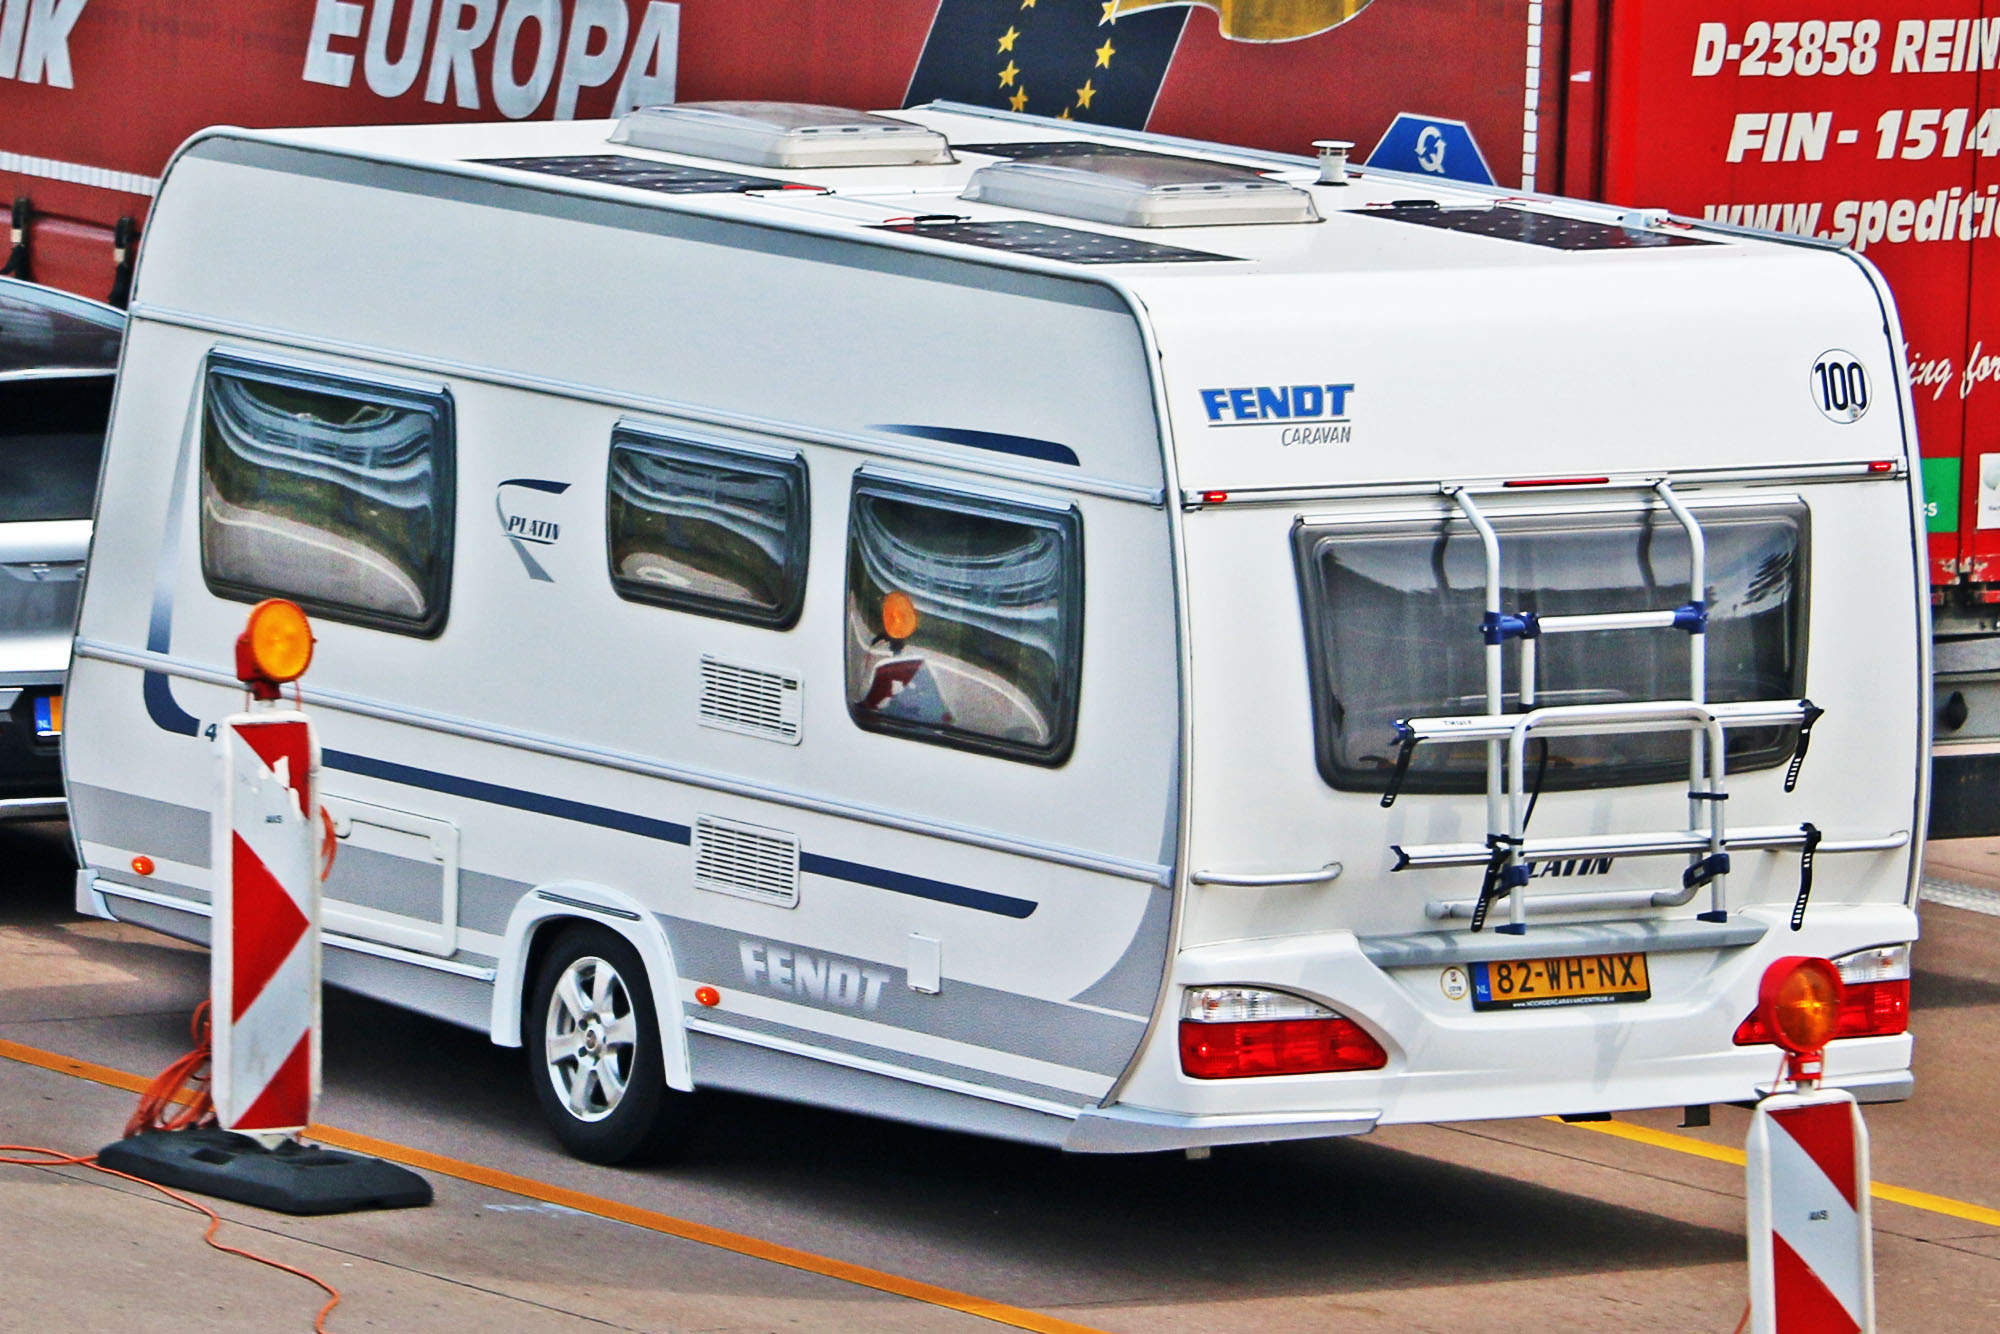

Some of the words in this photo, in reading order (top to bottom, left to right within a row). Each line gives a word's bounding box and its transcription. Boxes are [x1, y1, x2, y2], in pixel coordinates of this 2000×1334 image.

[302, 0, 684, 120] EUROPA
[1691, 19, 1881, 77] D-23858
[1725, 112, 1833, 163] FIN
[1198, 383, 1355, 421] FENDT
[1815, 361, 1867, 411] 100
[1281, 426, 1352, 446] CARAVAN
[508, 515, 560, 540] PLATIN
[739, 939, 891, 1012] FENDT
[1476, 985, 1489, 994] NL
[1497, 955, 1638, 994] 82-WH-NX
